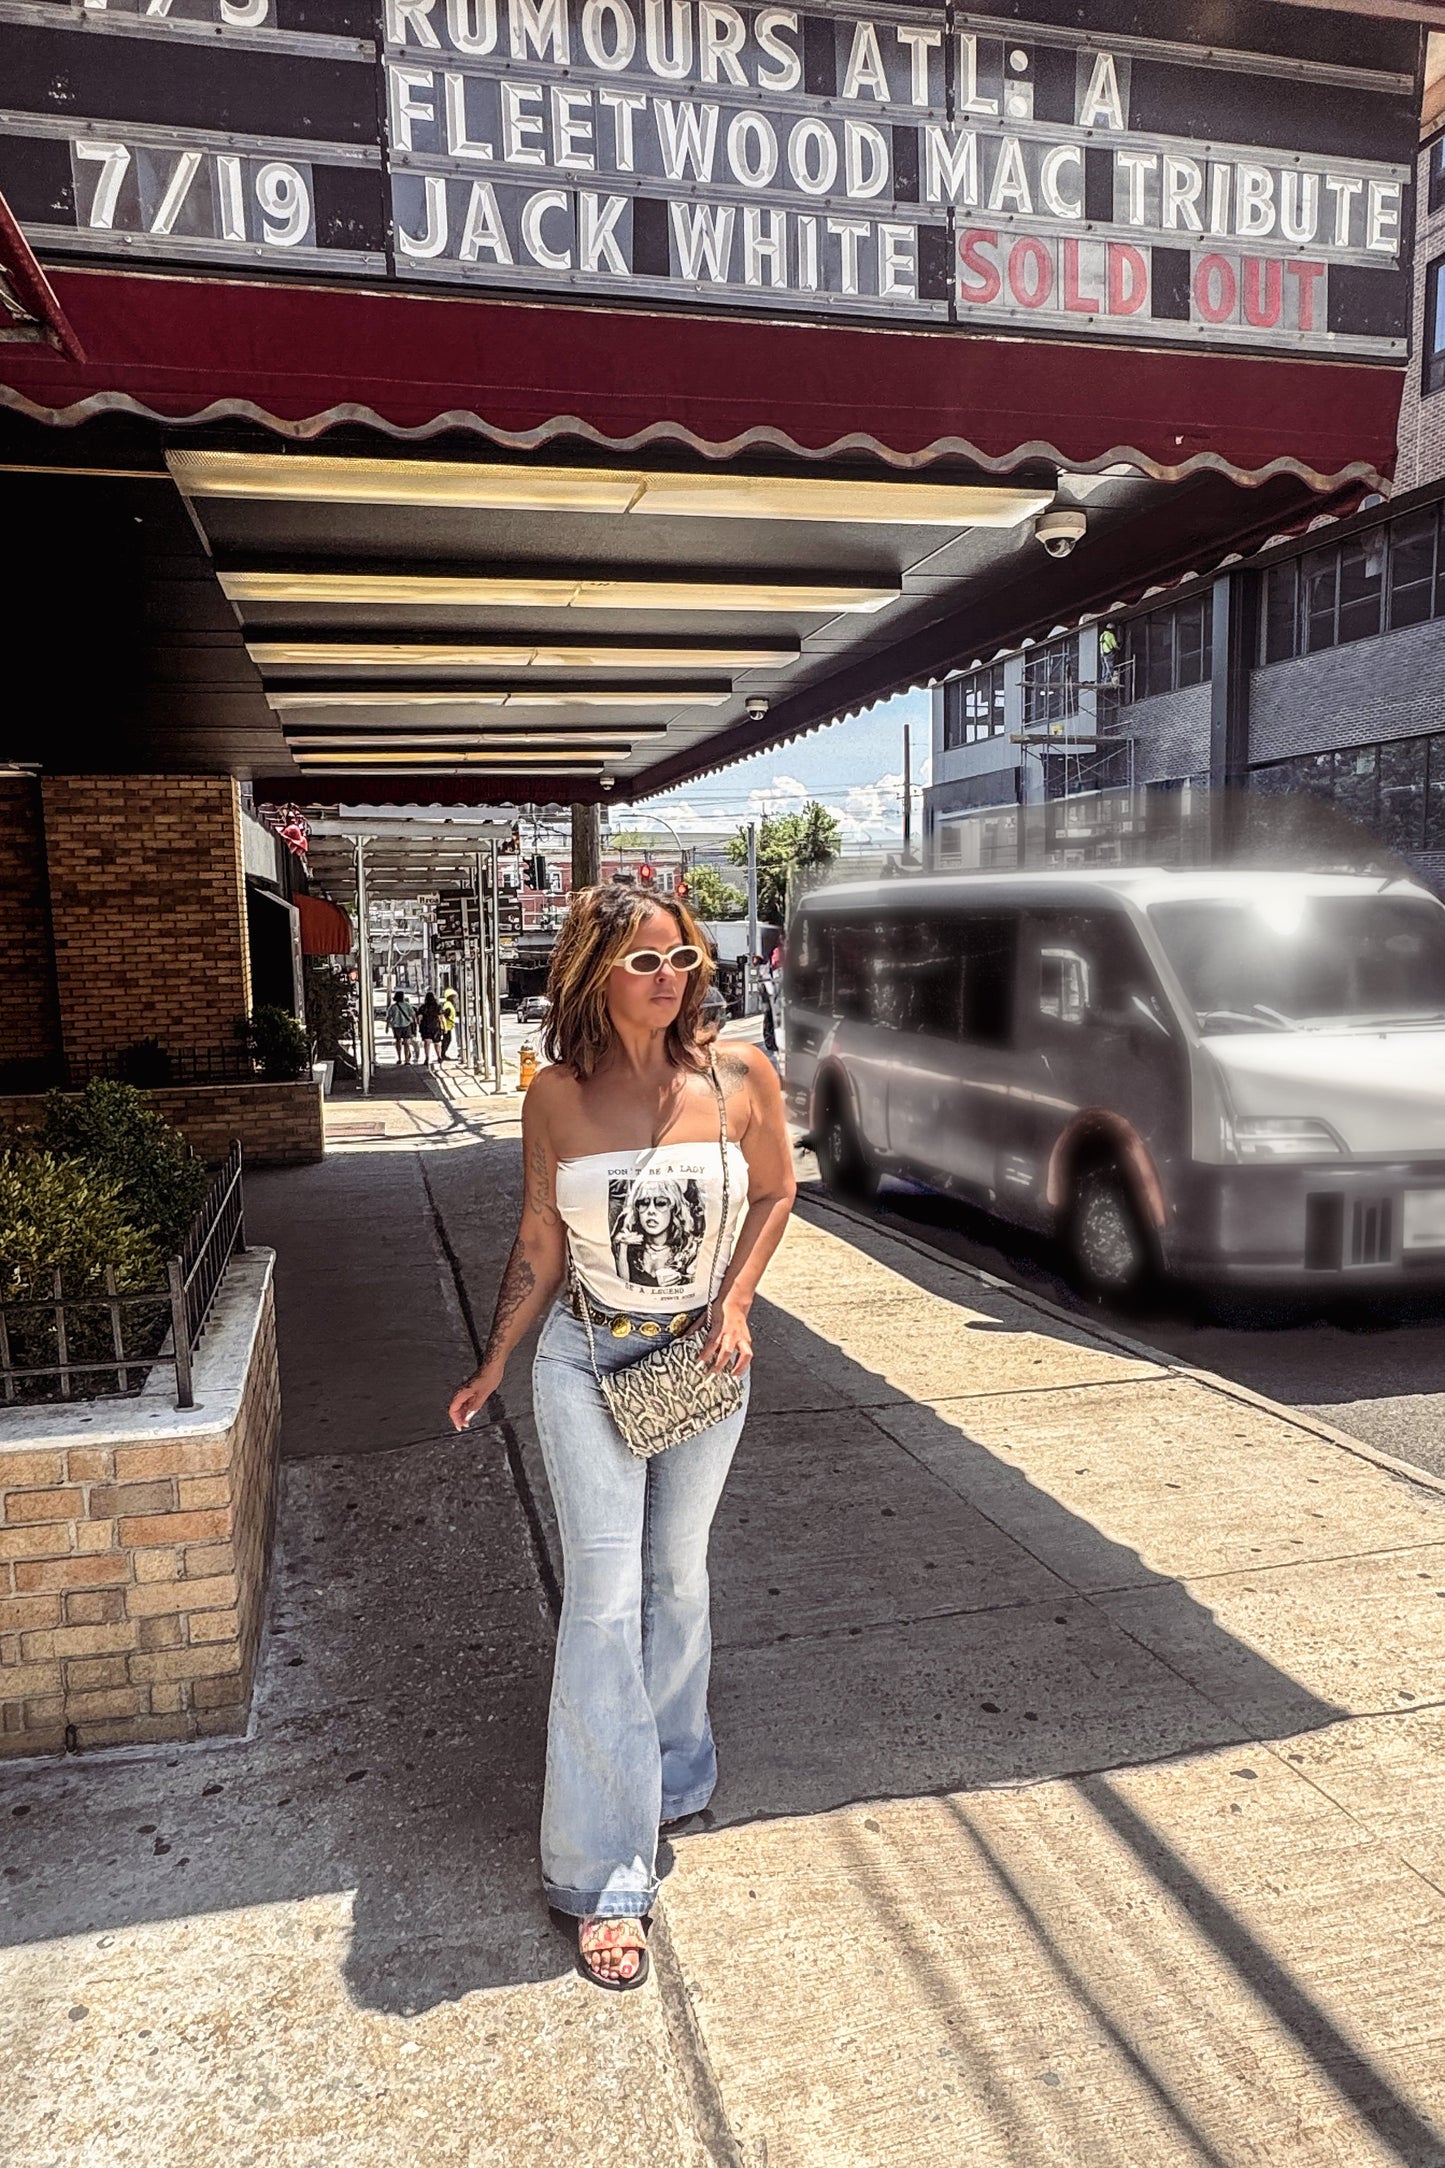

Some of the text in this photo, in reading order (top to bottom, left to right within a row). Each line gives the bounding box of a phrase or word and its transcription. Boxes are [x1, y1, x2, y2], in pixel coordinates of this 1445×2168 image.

[387, 0, 802, 92] RUMOURS
[1079, 53, 1126, 131] A
[75, 140, 312, 247] 7/19
[389, 64, 1400, 254] FLEETWOOD MAC TRIBUTE
[398, 177, 1325, 331] JACK WHITE SOLD OUT
[607, 1168, 642, 1176] DON'T
[667, 1165, 674, 1173] A
[680, 1165, 705, 1174] LADY
